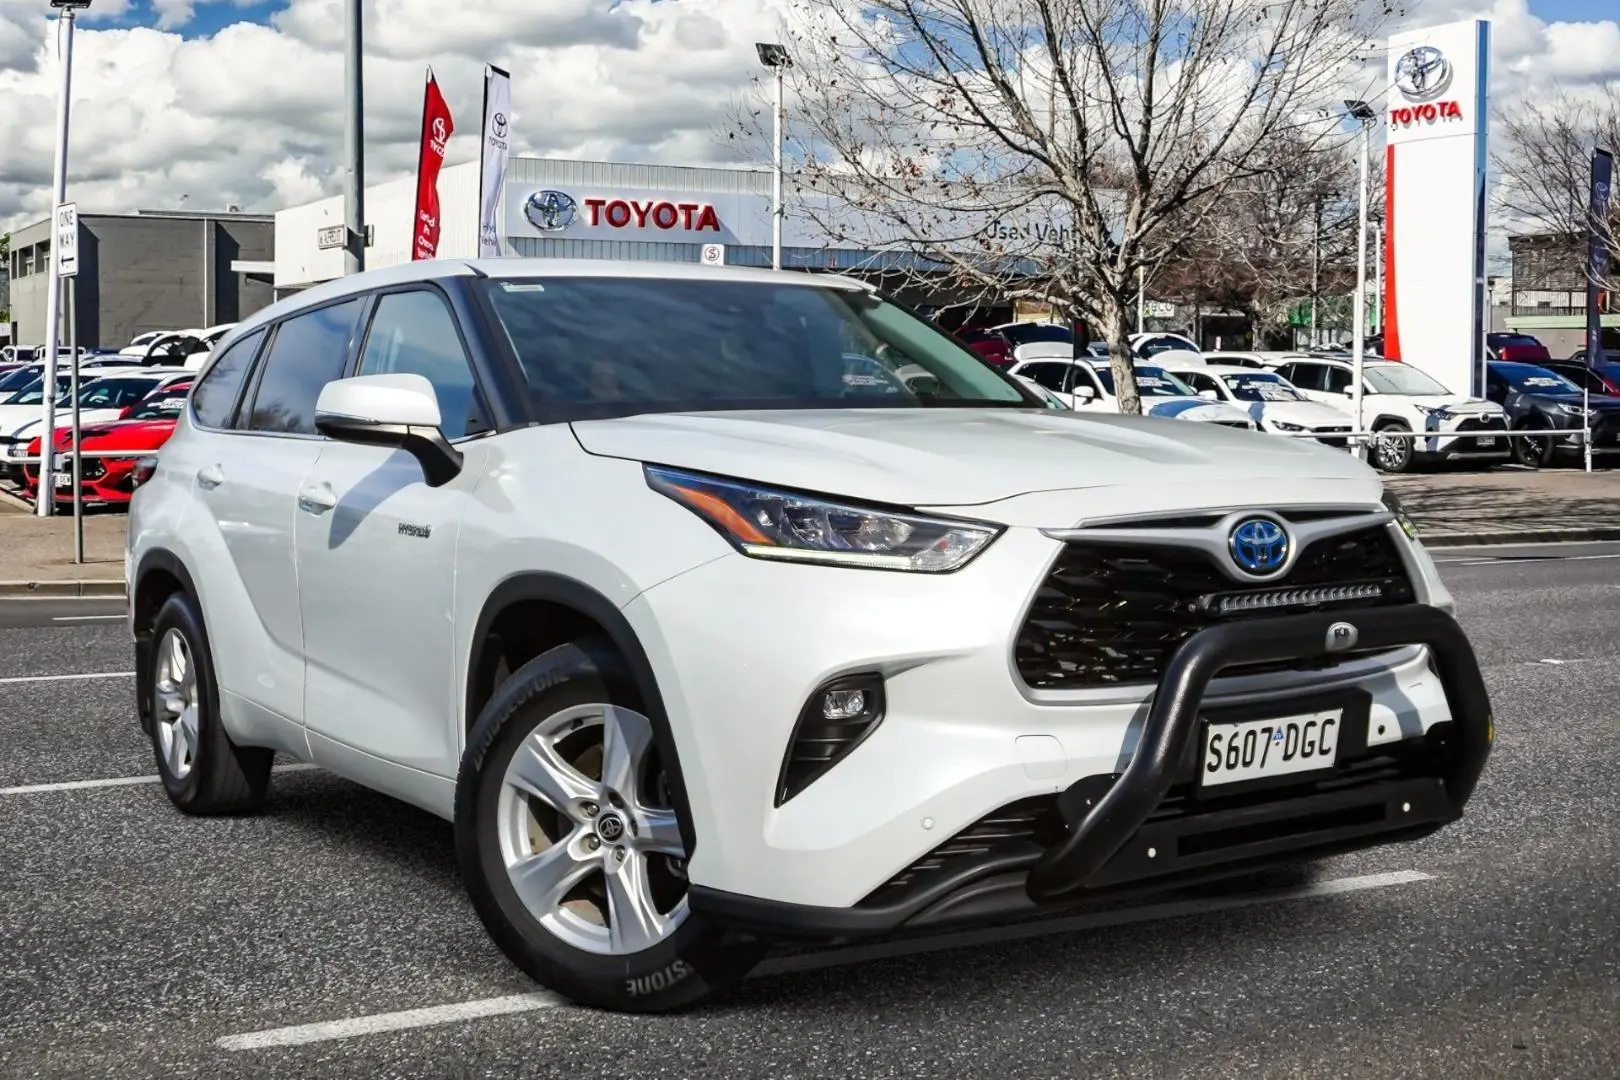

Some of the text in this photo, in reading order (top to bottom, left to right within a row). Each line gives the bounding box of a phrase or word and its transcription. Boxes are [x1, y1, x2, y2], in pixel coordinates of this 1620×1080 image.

[1389, 101, 1462, 125] TOYOTA
[59, 209, 74, 228] ONE
[584, 199, 720, 231] TOYOTA
[59, 231, 75, 249] WAY
[1035, 223, 1070, 240] Veh
[1206, 718, 1336, 773] S607 DGC
